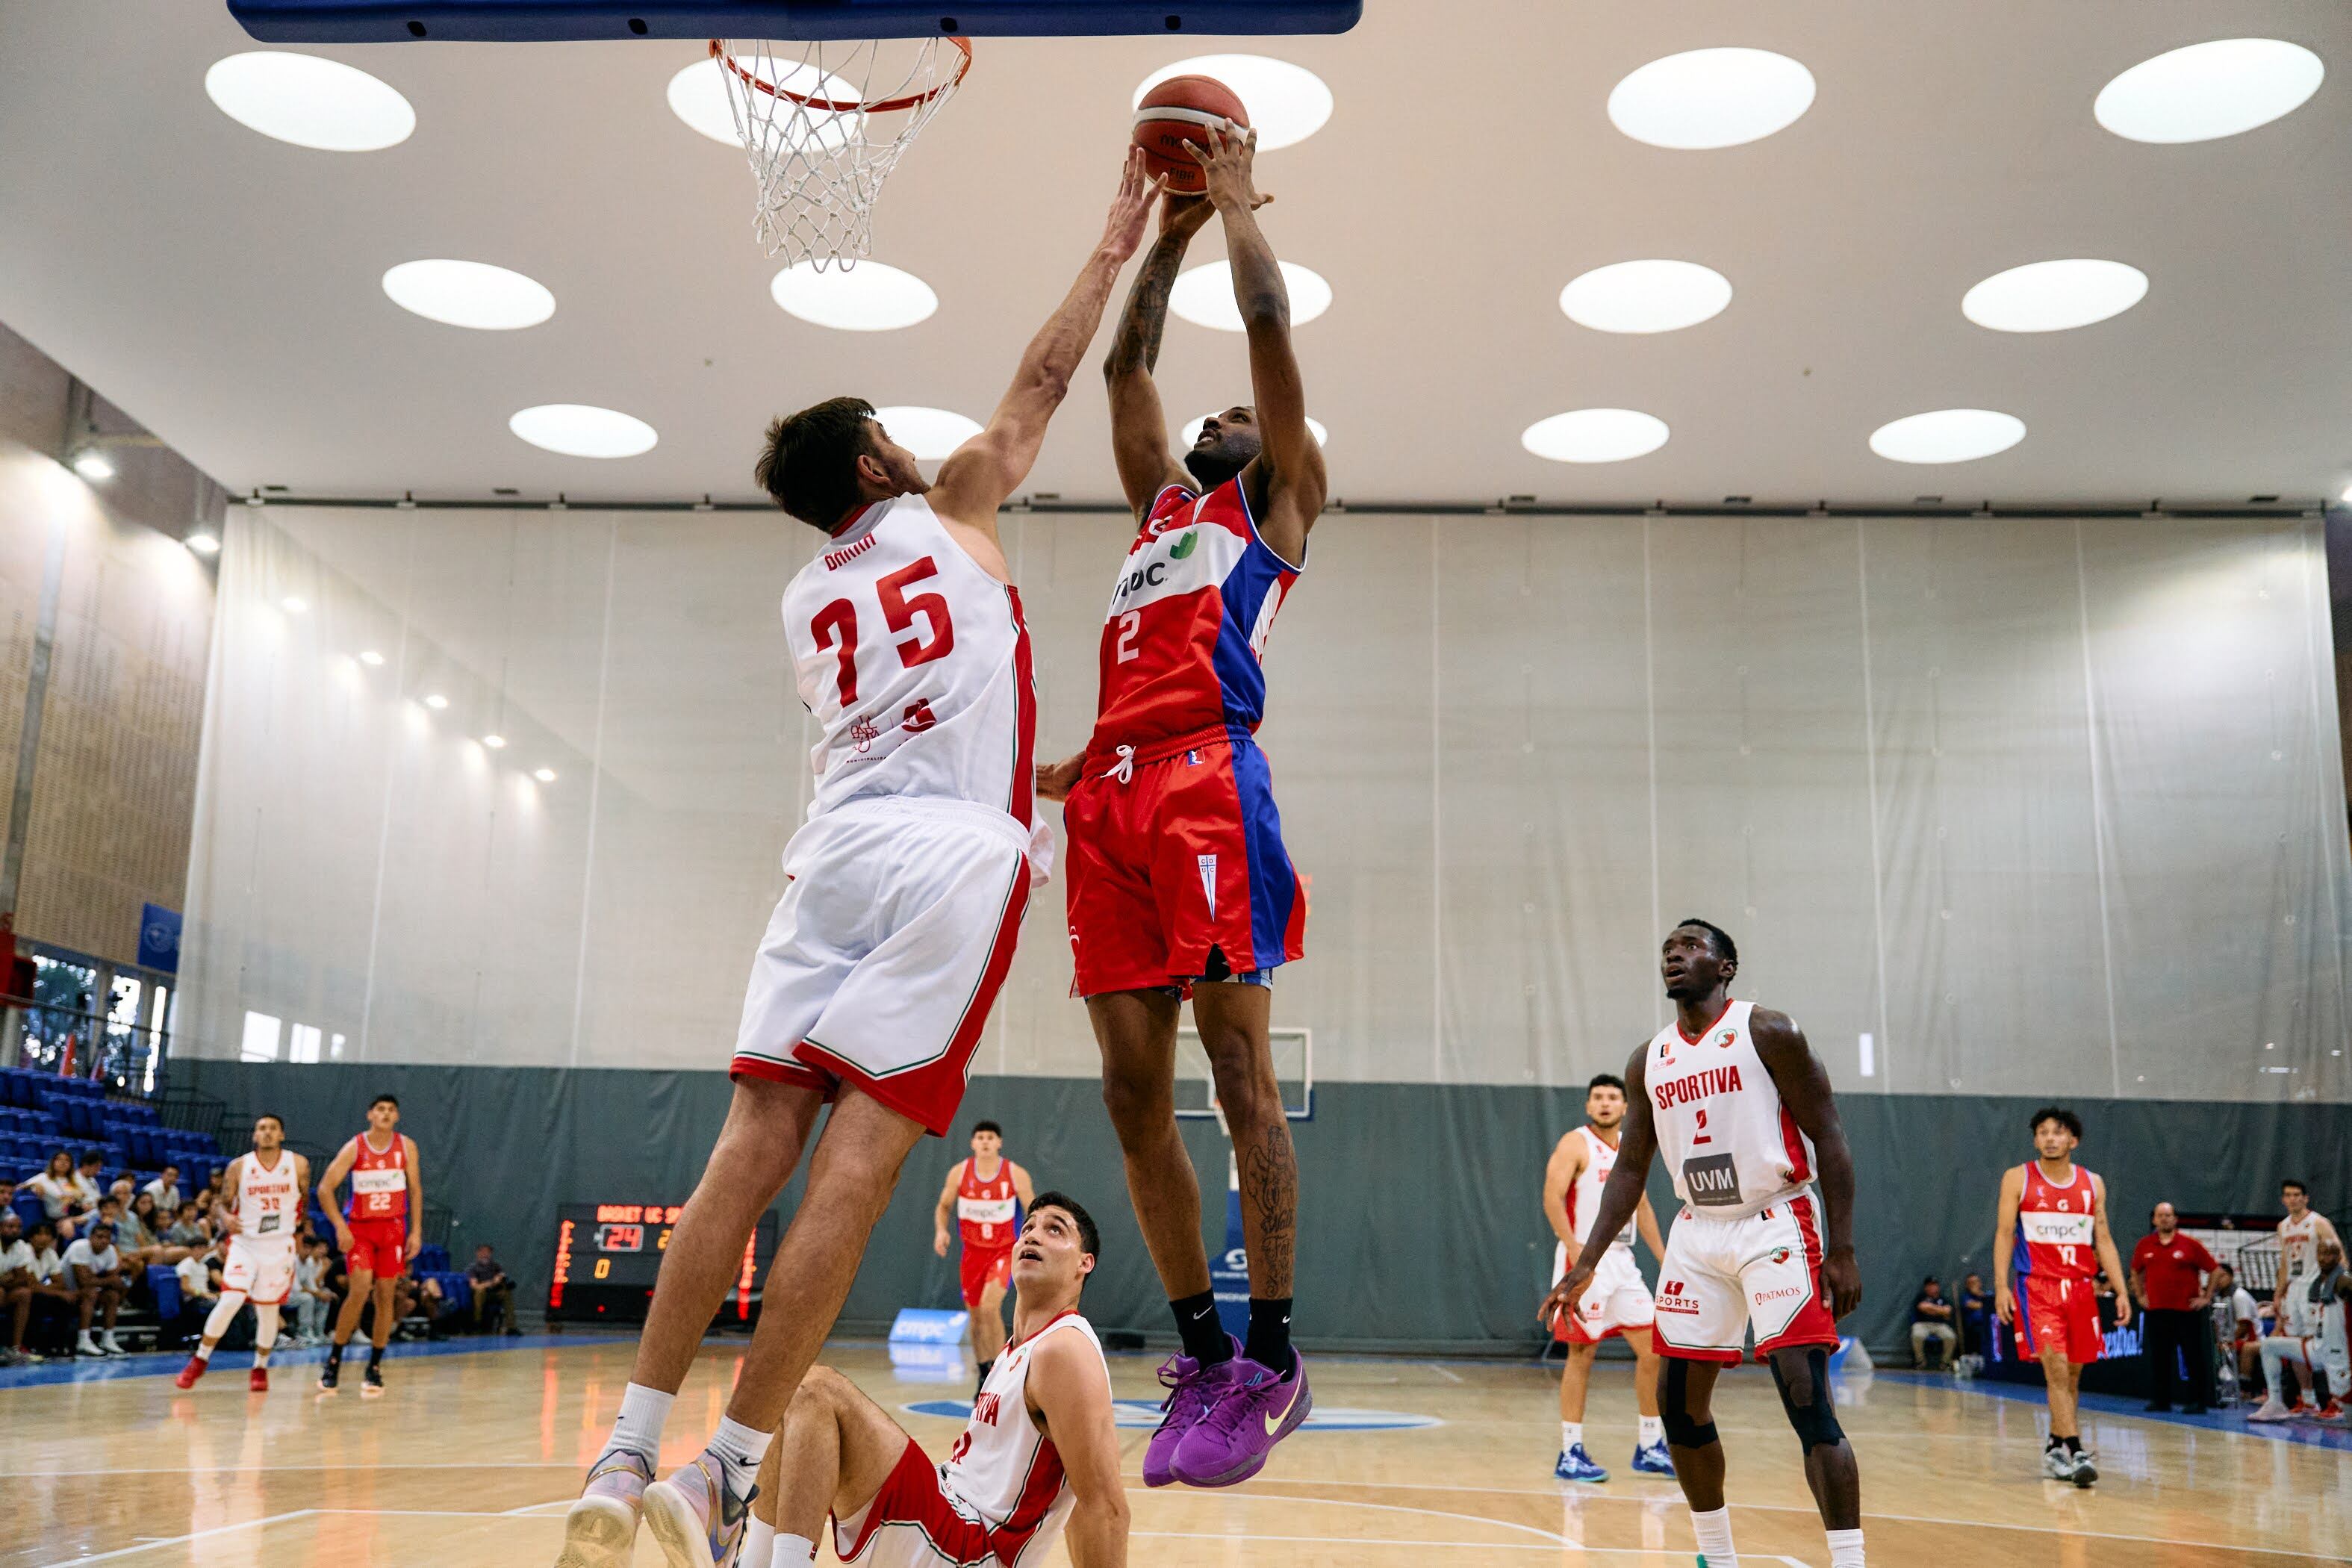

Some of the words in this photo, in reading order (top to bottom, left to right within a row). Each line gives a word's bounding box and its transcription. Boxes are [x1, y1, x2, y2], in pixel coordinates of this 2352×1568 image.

[1117, 610, 1141, 665] 2
[1655, 1065, 1743, 1110] SPORTIVA
[1693, 1109, 1711, 1145] 2
[1690, 1168, 1734, 1192] UVM
[370, 1193, 391, 1210] 22
[606, 1226, 641, 1250] 24
[2037, 1224, 2077, 1239] cmpc
[594, 1259, 611, 1279] 0
[1762, 1287, 1801, 1302] PATMOS
[896, 1321, 946, 1340] cmpc
